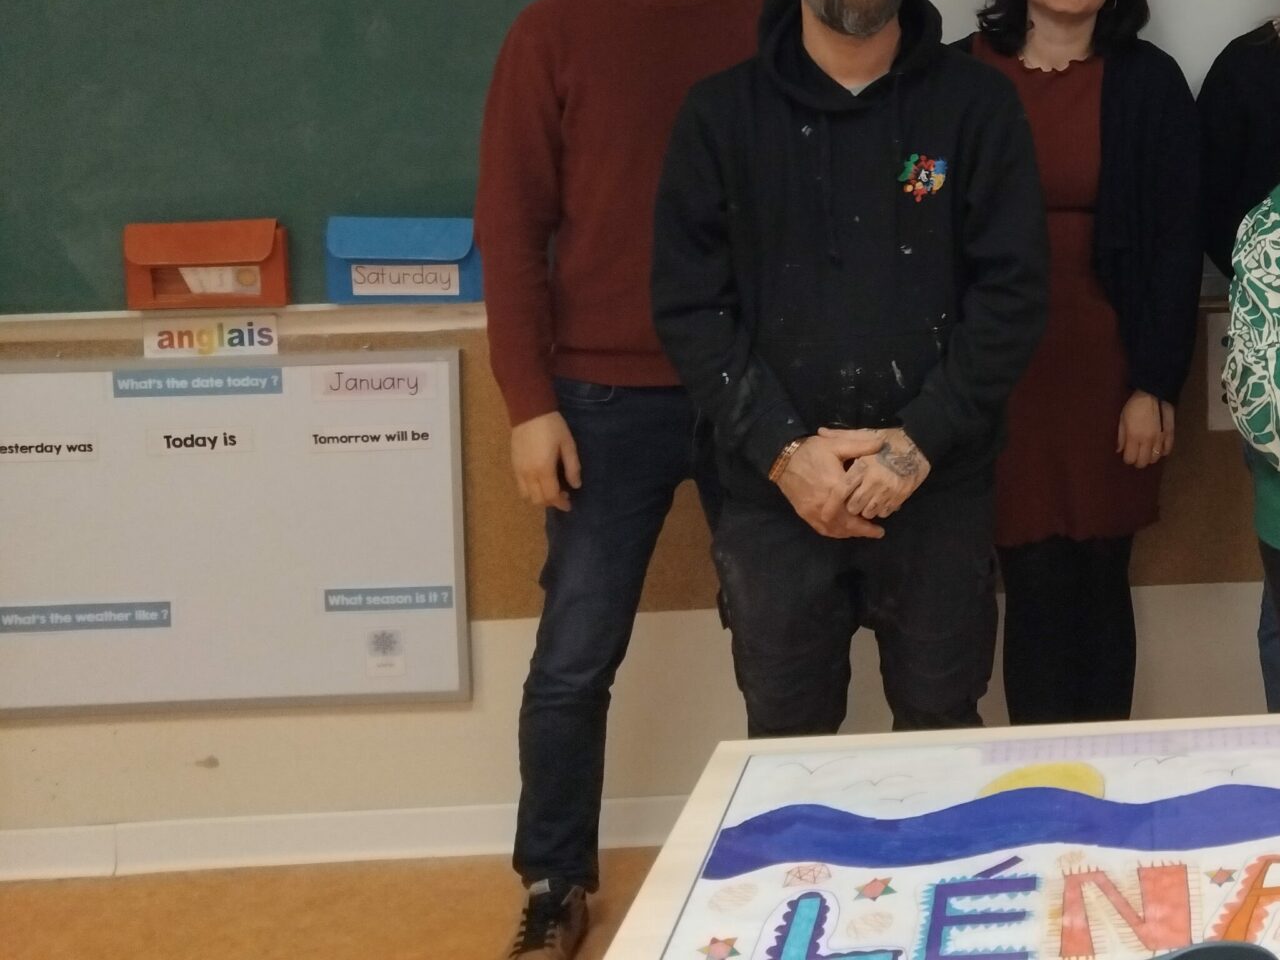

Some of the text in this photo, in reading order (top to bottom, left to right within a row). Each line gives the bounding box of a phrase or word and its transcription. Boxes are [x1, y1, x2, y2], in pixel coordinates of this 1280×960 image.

[353, 265, 451, 290] Saturday
[157, 321, 274, 354] anglais
[117, 376, 162, 390] What's
[166, 376, 188, 389] the
[191, 375, 223, 389] date
[227, 375, 267, 390] today
[329, 371, 419, 396] January
[164, 432, 237, 450] Today is
[312, 430, 429, 445] Tomorrow will be
[0, 441, 93, 455] esterday was
[328, 594, 362, 606] What
[366, 594, 412, 605] season
[415, 592, 426, 603] is
[428, 591, 438, 603] it
[1, 614, 46, 625] What's
[50, 612, 72, 624] the
[75, 610, 131, 623] weather
[135, 609, 158, 621] like
